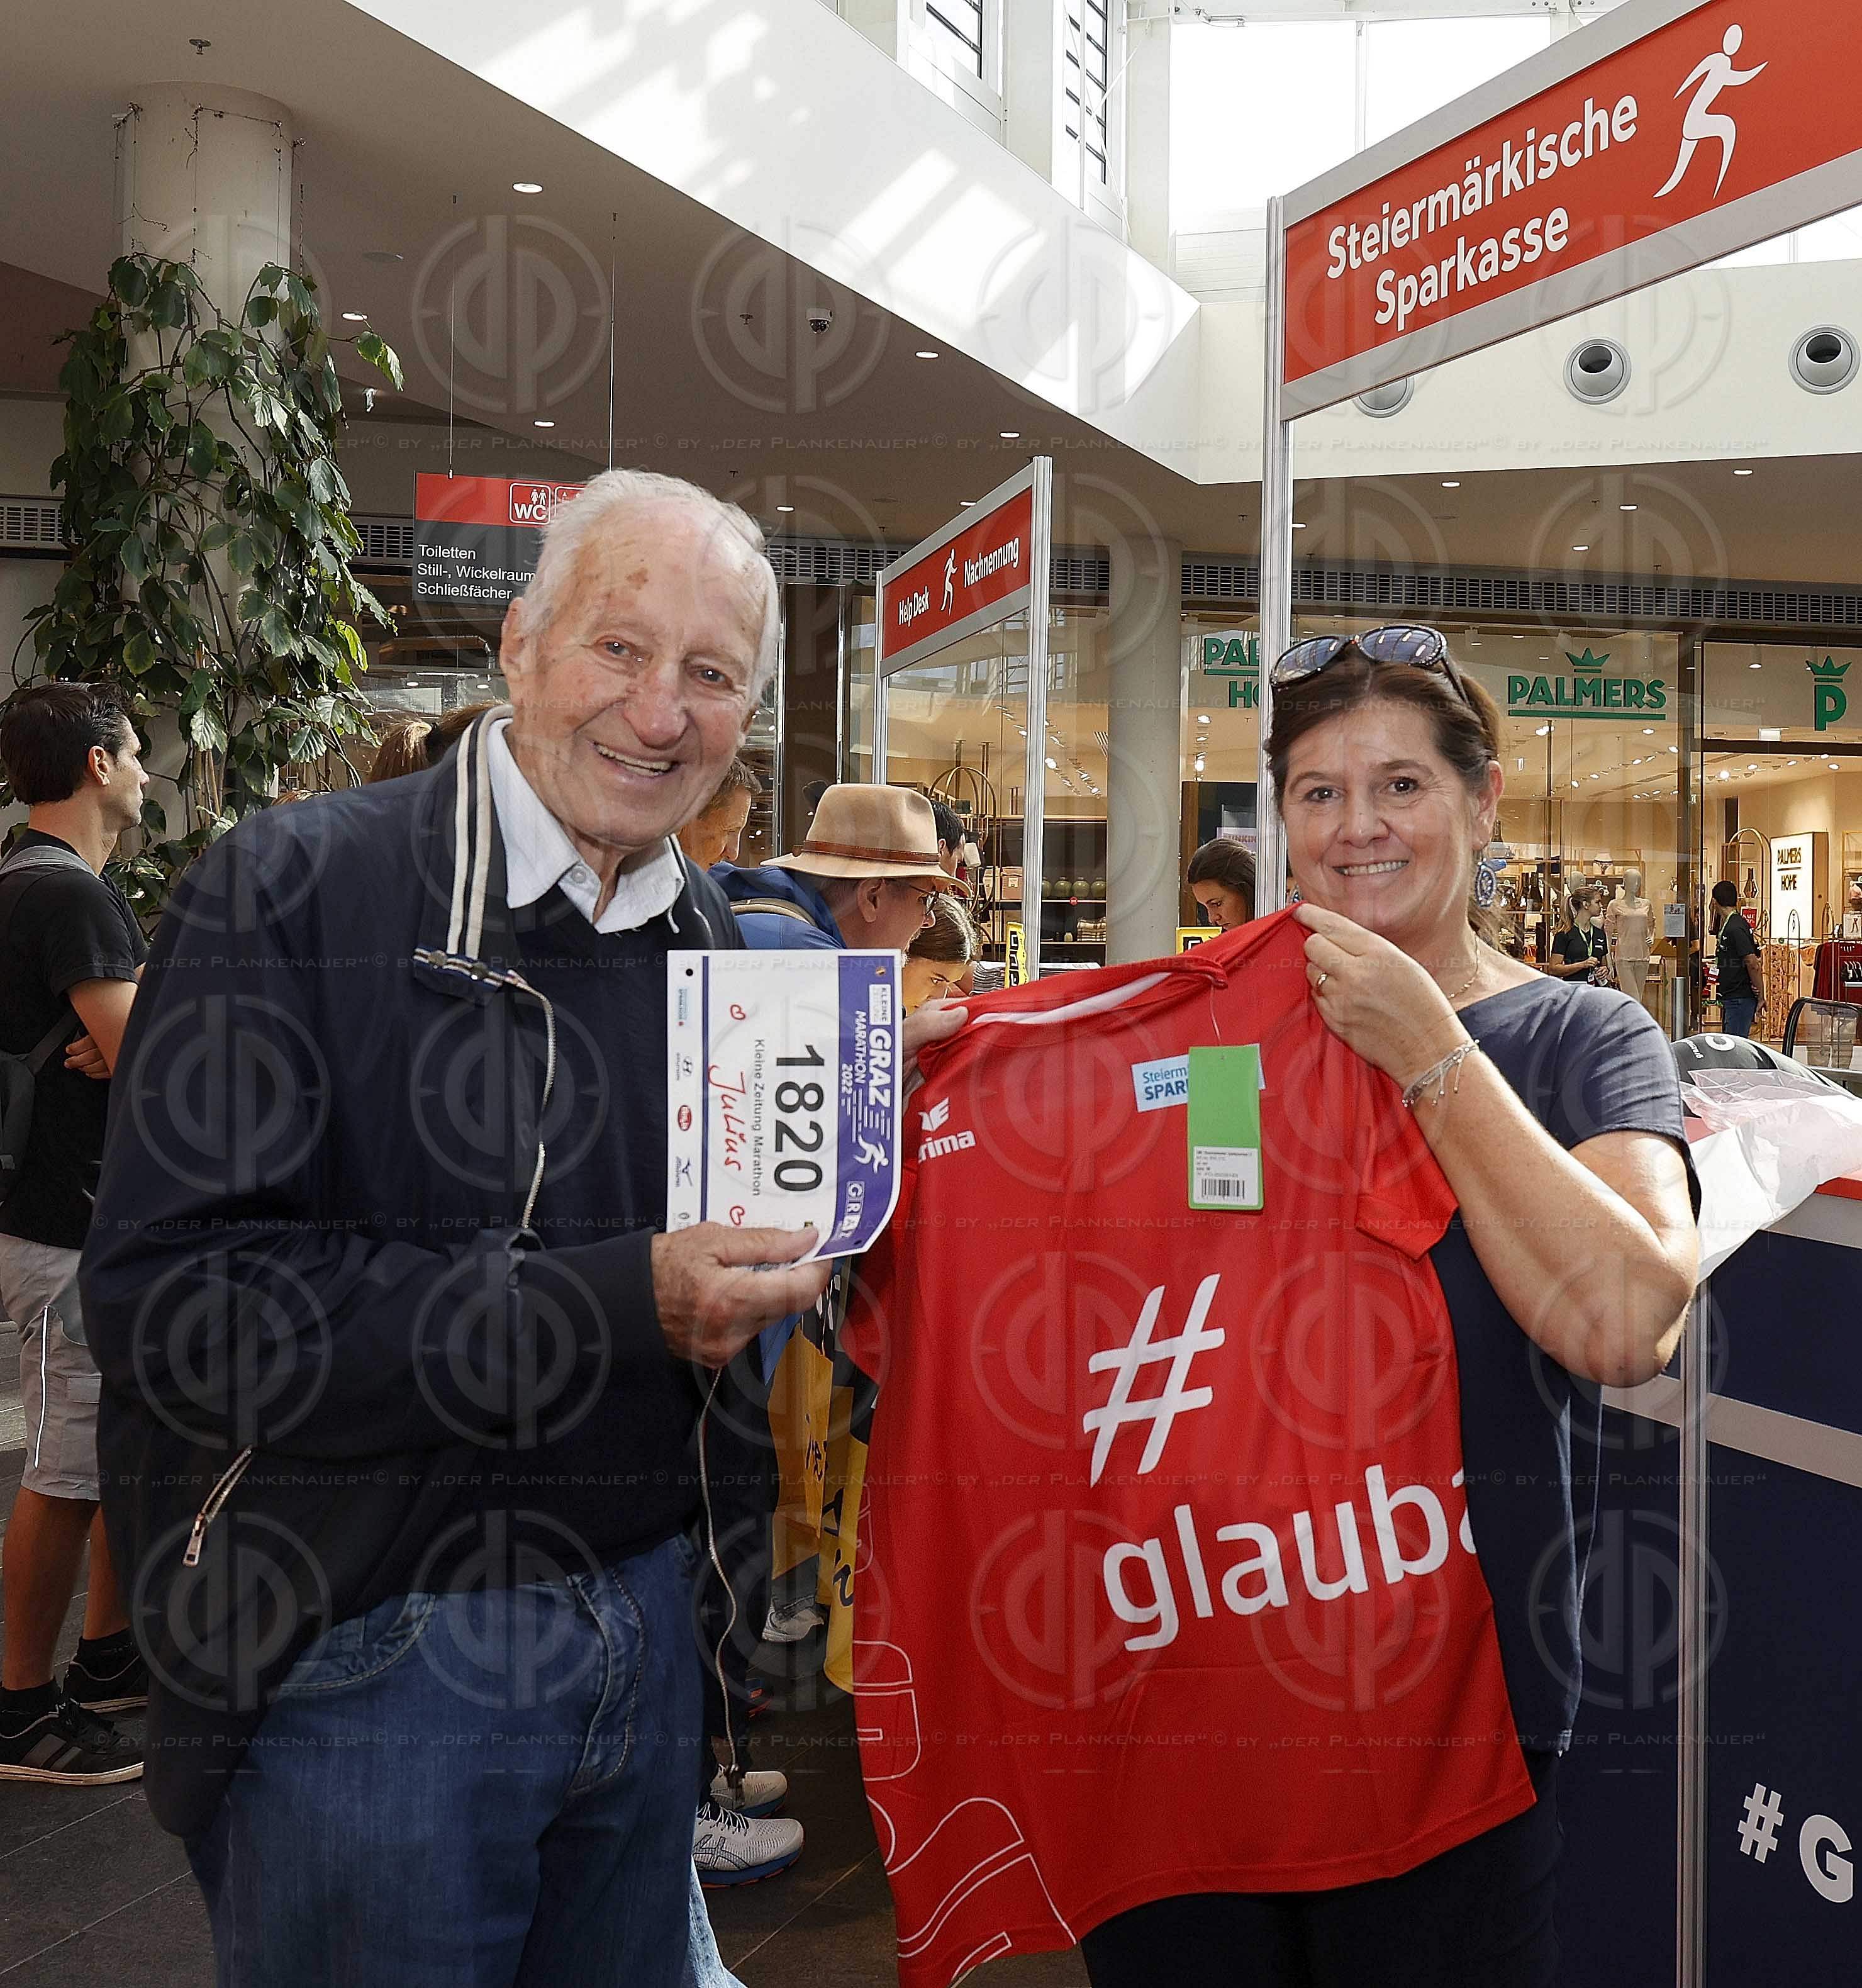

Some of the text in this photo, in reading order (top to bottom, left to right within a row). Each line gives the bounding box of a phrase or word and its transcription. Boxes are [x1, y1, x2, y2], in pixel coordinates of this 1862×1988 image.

[1327, 94, 1639, 280] Steiermärkische
[1374, 206, 1569, 333] Sparkasse
[513, 503, 547, 520] WC
[418, 544, 476, 560] Toiletten
[964, 537, 1020, 588] Nachnennung
[417, 563, 452, 578] Still-,
[417, 582, 513, 600] Schließfächer
[898, 586, 930, 627] Help Desk
[1229, 681, 1259, 708] H
[1508, 675, 1666, 709] PALMERS
[1777, 847, 1802, 865] PALMERS
[1781, 874, 1797, 891] HOME
[854, 1010, 867, 1084] MARATHON
[840, 1063, 854, 1094] 2022
[868, 1027, 892, 1108] GRAZ
[1144, 1079, 1188, 1100] SPAR
[707, 1064, 747, 1171] Julius
[752, 1039, 765, 1196] Kleine Zeitung Marathon
[774, 1044, 825, 1193] 1820
[917, 1130, 976, 1164] rima
